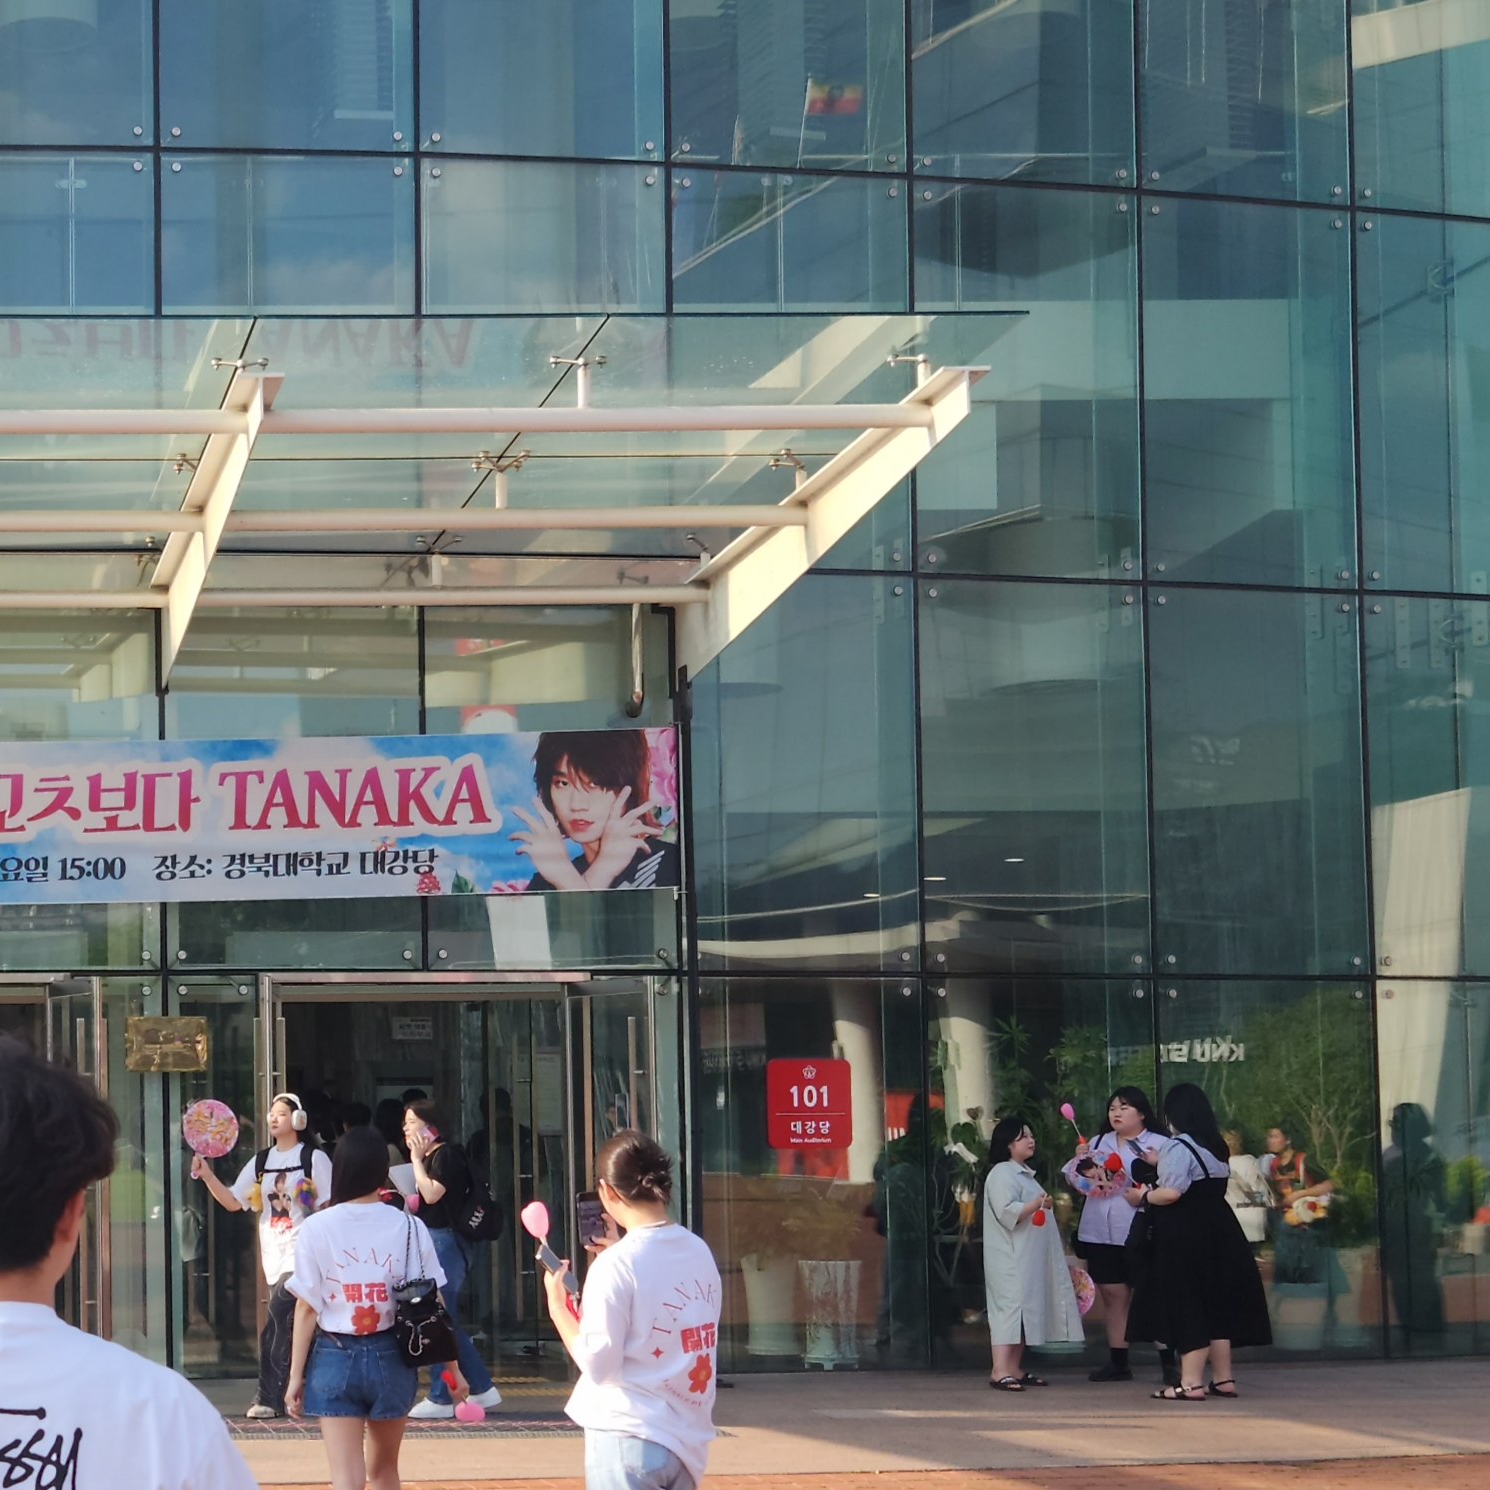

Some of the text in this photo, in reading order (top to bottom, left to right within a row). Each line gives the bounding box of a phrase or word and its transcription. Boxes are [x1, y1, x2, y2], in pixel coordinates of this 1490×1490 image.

[218, 763, 491, 831] TANAKA
[57, 854, 126, 881] 15:00
[152, 852, 213, 881] 장소:
[222, 849, 351, 880] 경북대학교
[359, 847, 439, 876] 대강당
[789, 1085, 828, 1108] 101
[790, 1120, 831, 1135] 대강당
